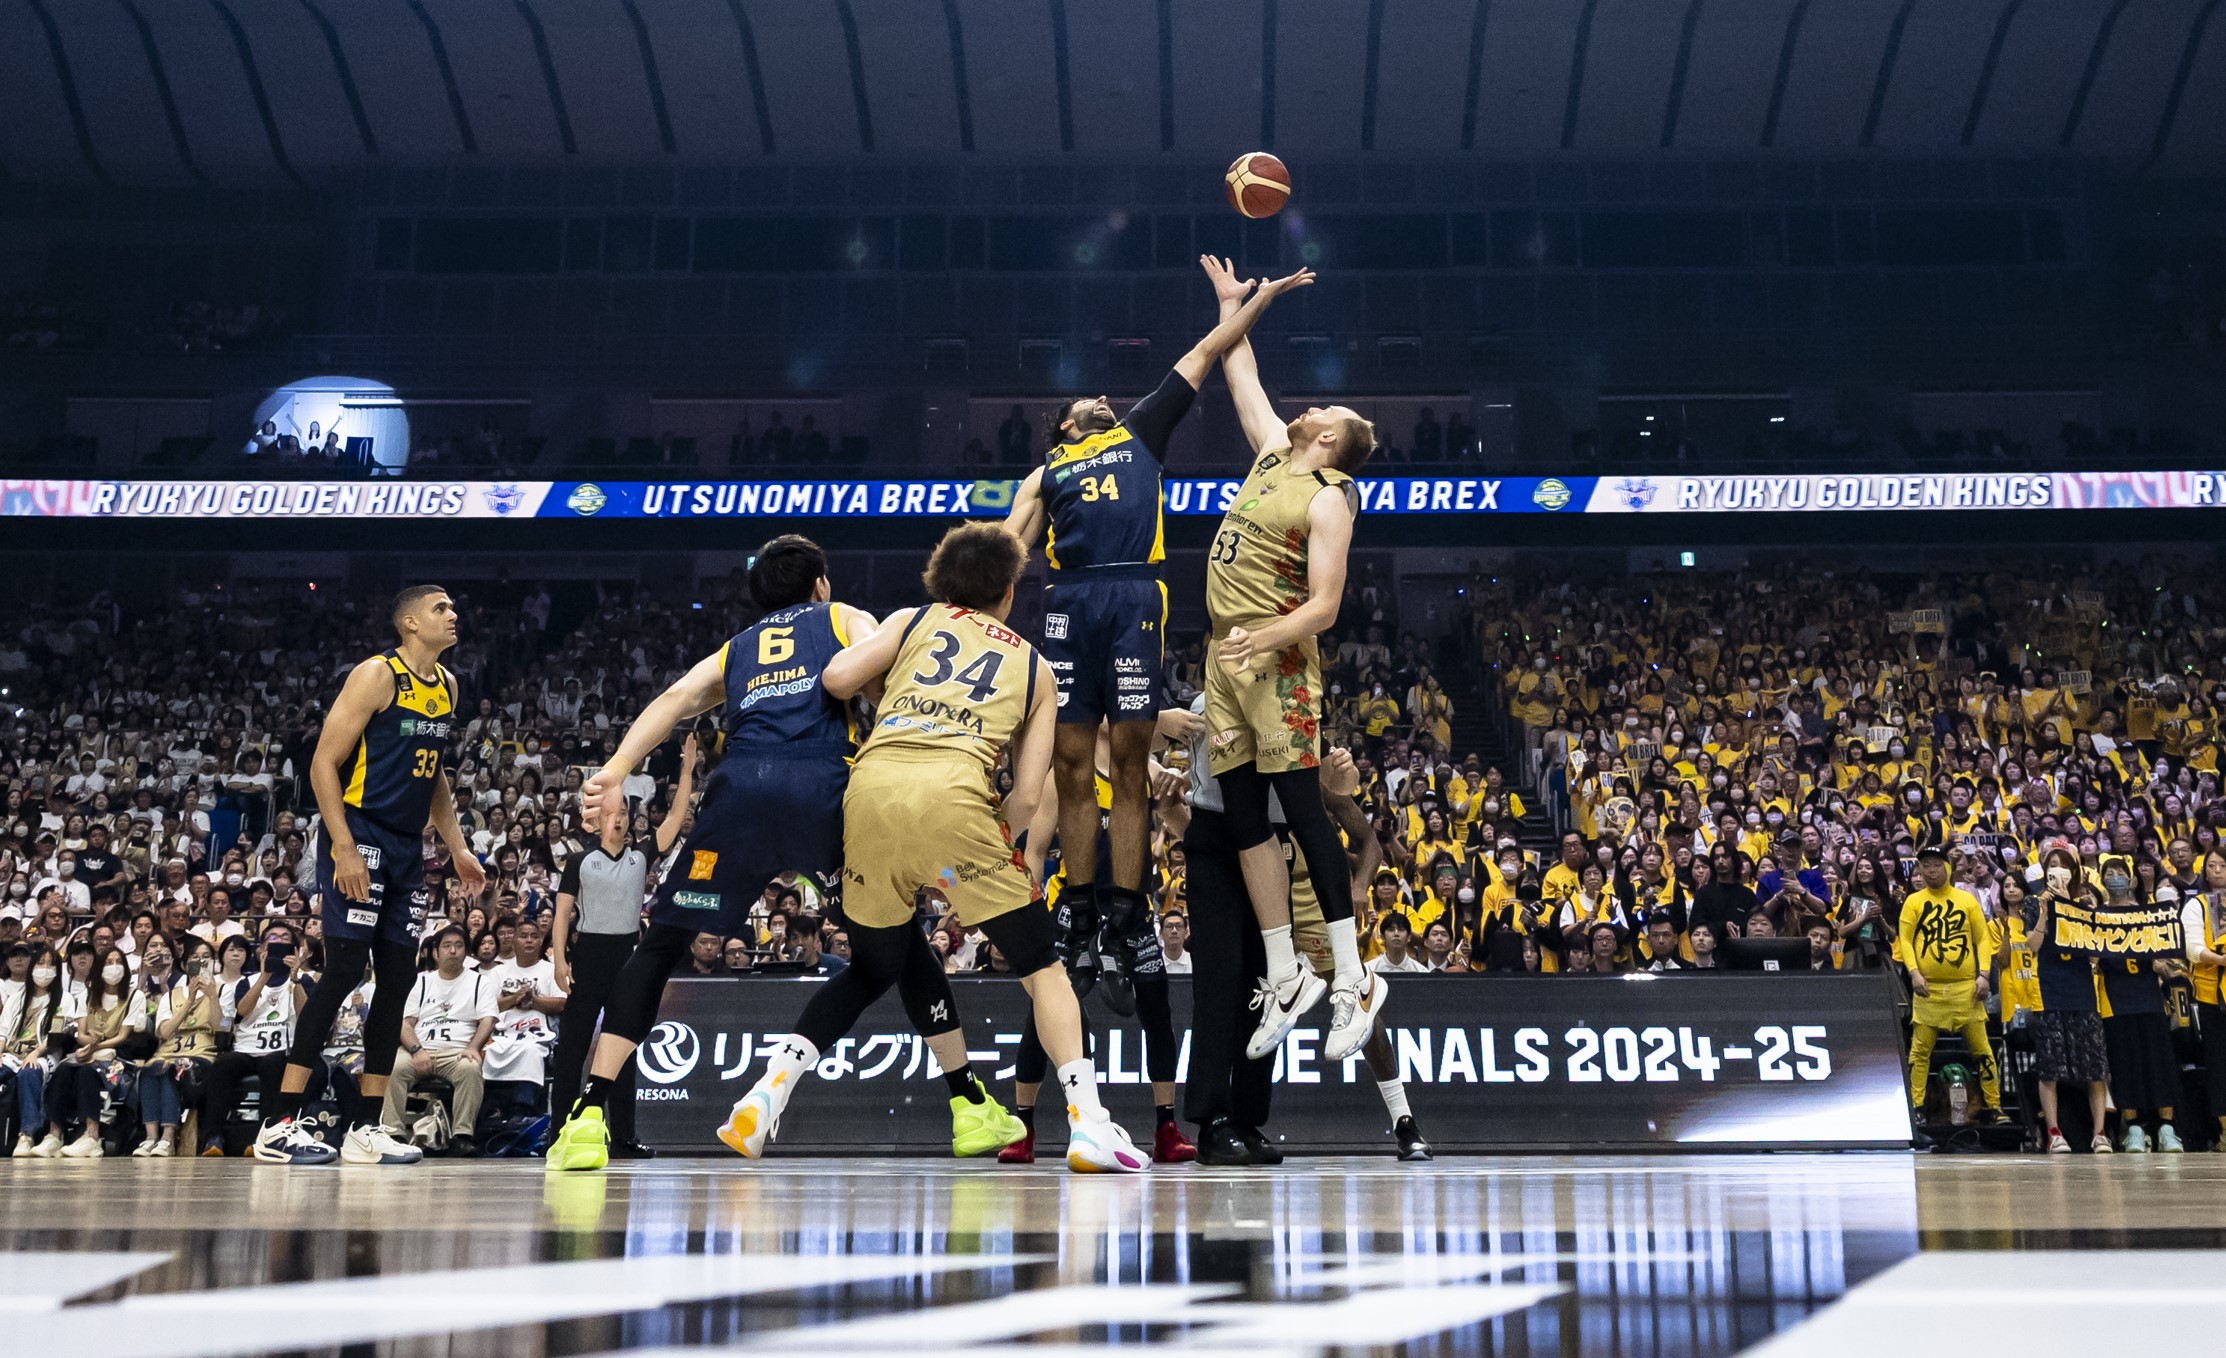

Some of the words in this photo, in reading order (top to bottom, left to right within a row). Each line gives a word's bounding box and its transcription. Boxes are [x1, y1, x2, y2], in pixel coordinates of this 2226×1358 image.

[1071, 450, 1132, 474] 栃木銀行
[92, 484, 224, 515] RYUKYU
[229, 484, 360, 515] GOLDEN
[364, 484, 464, 515] KINGS
[642, 484, 868, 515] UTSUNOMIYA
[879, 484, 975, 514] BREX
[1079, 473, 1119, 502] 34
[1169, 481, 1396, 512] UTSYA
[1407, 480, 1501, 511] BREX
[1678, 479, 1803, 509] RYUKYU
[1816, 478, 1945, 508] GOLDEN
[1952, 476, 2052, 506] KINGS
[1210, 530, 1241, 566] 53
[757, 626, 795, 665] 6
[747, 666, 807, 692] HIEJIMA
[912, 629, 1005, 704] 34
[412, 748, 438, 778] 33
[956, 861, 976, 874] Bell
[959, 858, 1009, 883] System24
[172, 1034, 197, 1053] 34
[255, 1030, 283, 1050] 58
[1342, 1027, 1550, 1083] NALS
[1565, 1025, 1832, 1082] 2024-25
[635, 1088, 690, 1101] RESONA
